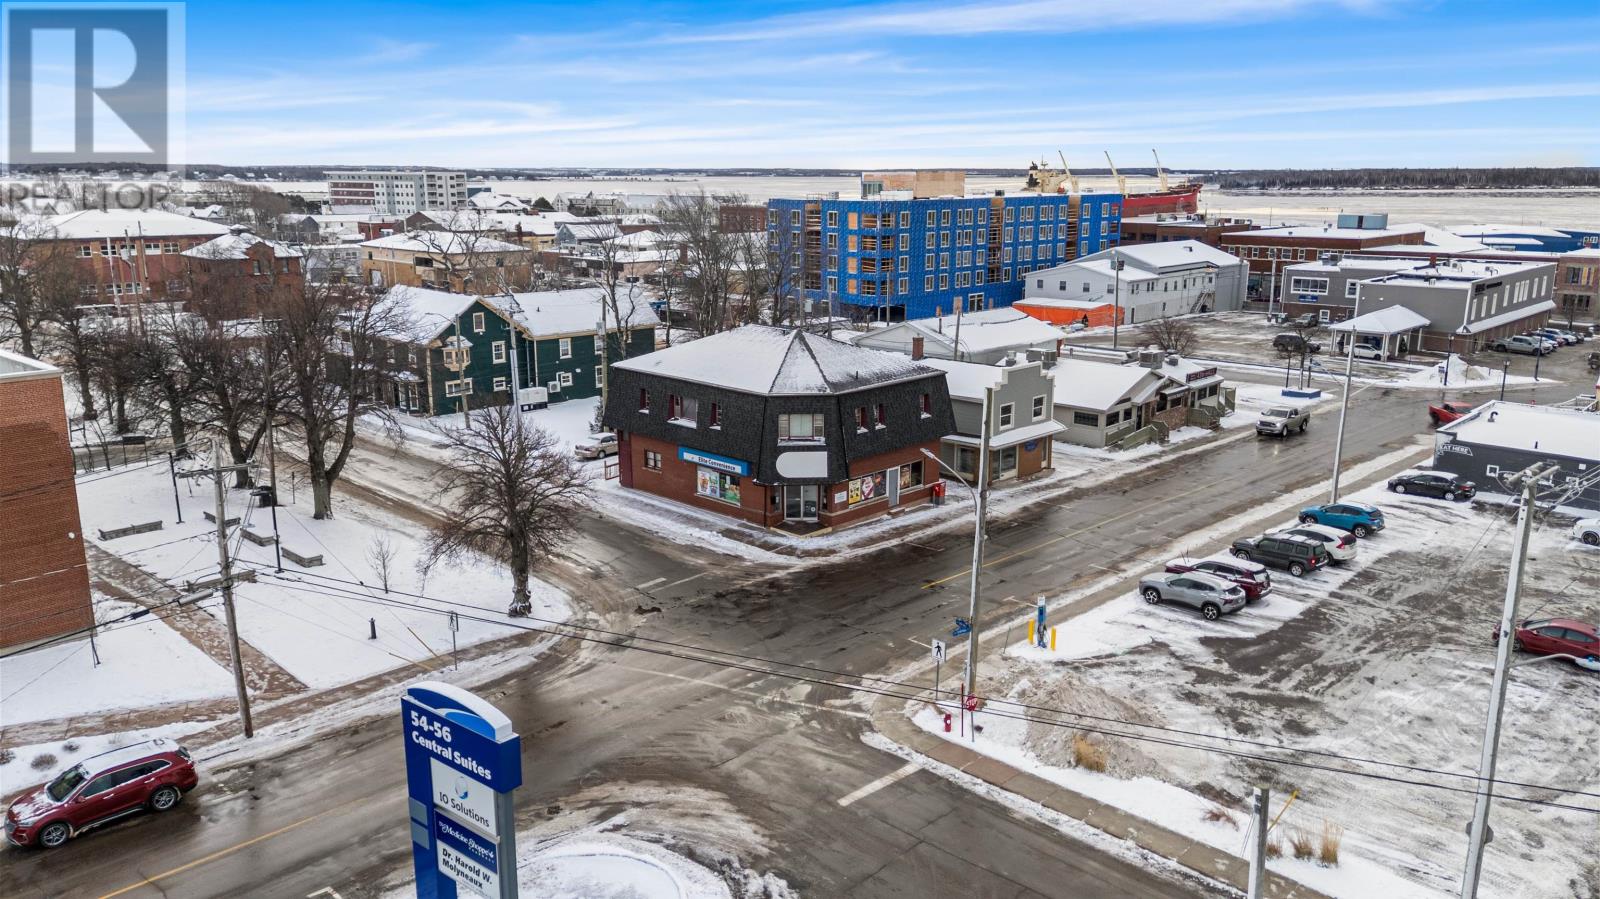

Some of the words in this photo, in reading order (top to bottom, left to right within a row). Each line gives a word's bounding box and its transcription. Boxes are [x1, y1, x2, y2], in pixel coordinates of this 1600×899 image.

[708, 459, 736, 471] Convenience
[410, 710, 452, 742] 54-56
[411, 730, 453, 760] Central
[453, 751, 492, 780] Suites
[450, 798, 490, 828] Solutions
[442, 848, 454, 861] Dr.
[455, 855, 481, 878] Harold
[482, 871, 493, 885] W.
[442, 858, 483, 889] Molyneaux
